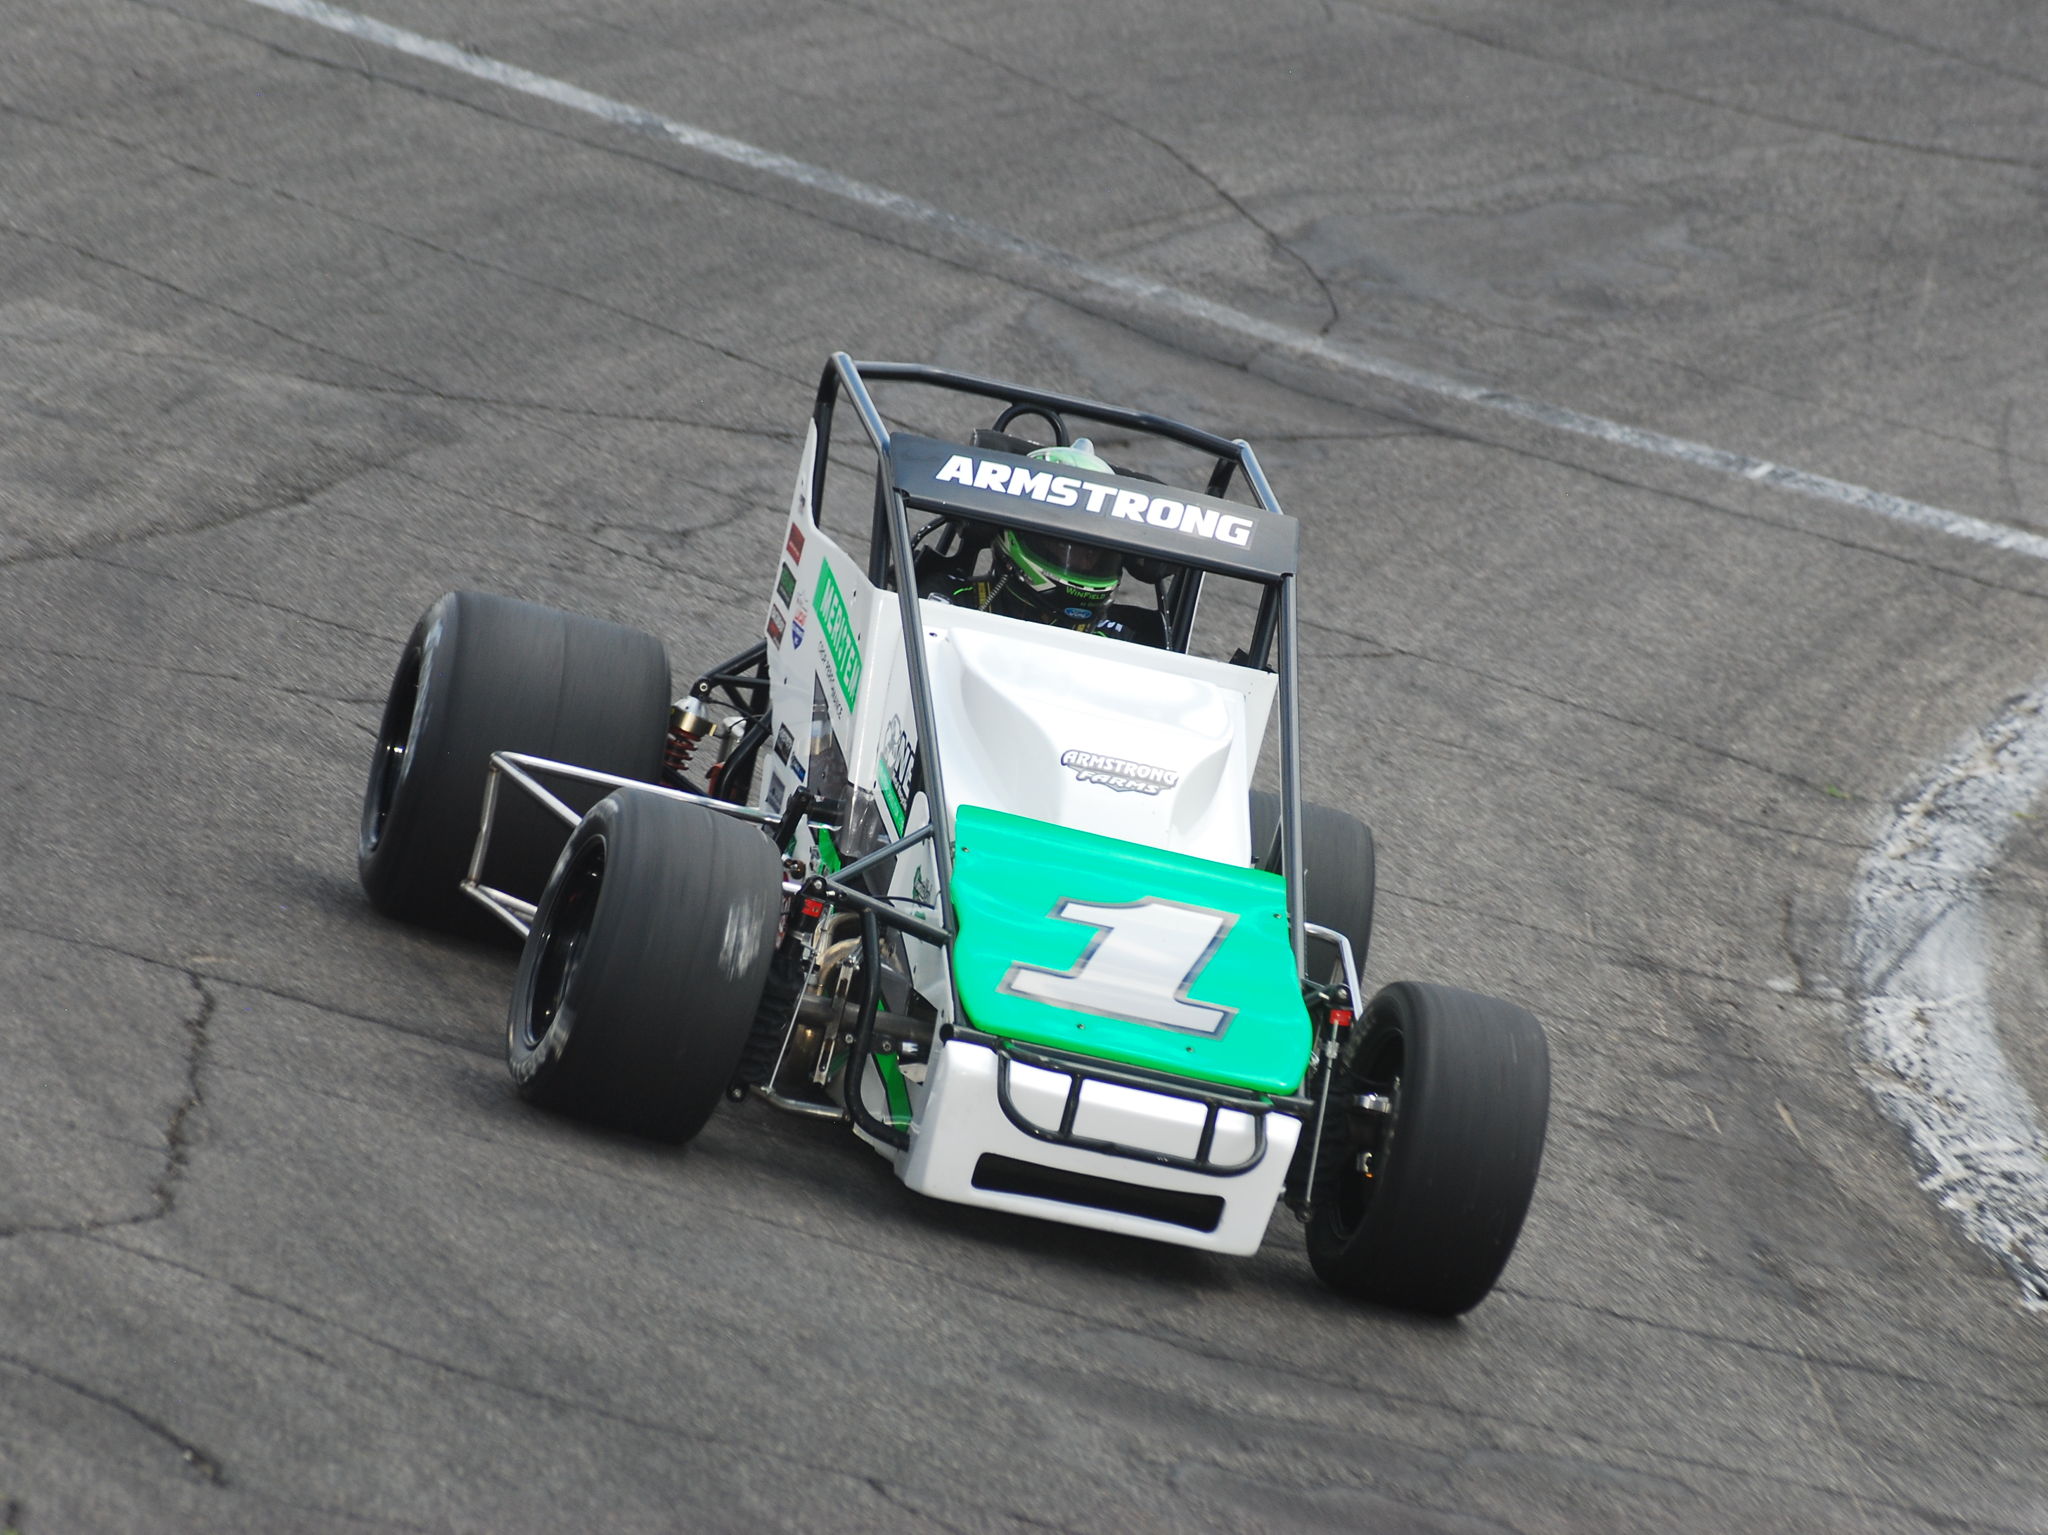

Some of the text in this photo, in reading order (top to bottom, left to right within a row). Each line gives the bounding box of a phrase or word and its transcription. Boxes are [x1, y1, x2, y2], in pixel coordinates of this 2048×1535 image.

[935, 454, 1254, 547] ARMSTRONG
[1061, 749, 1179, 787] ARMSTRONG
[1076, 769, 1160, 796] FARMS
[996, 895, 1240, 1040] 1
